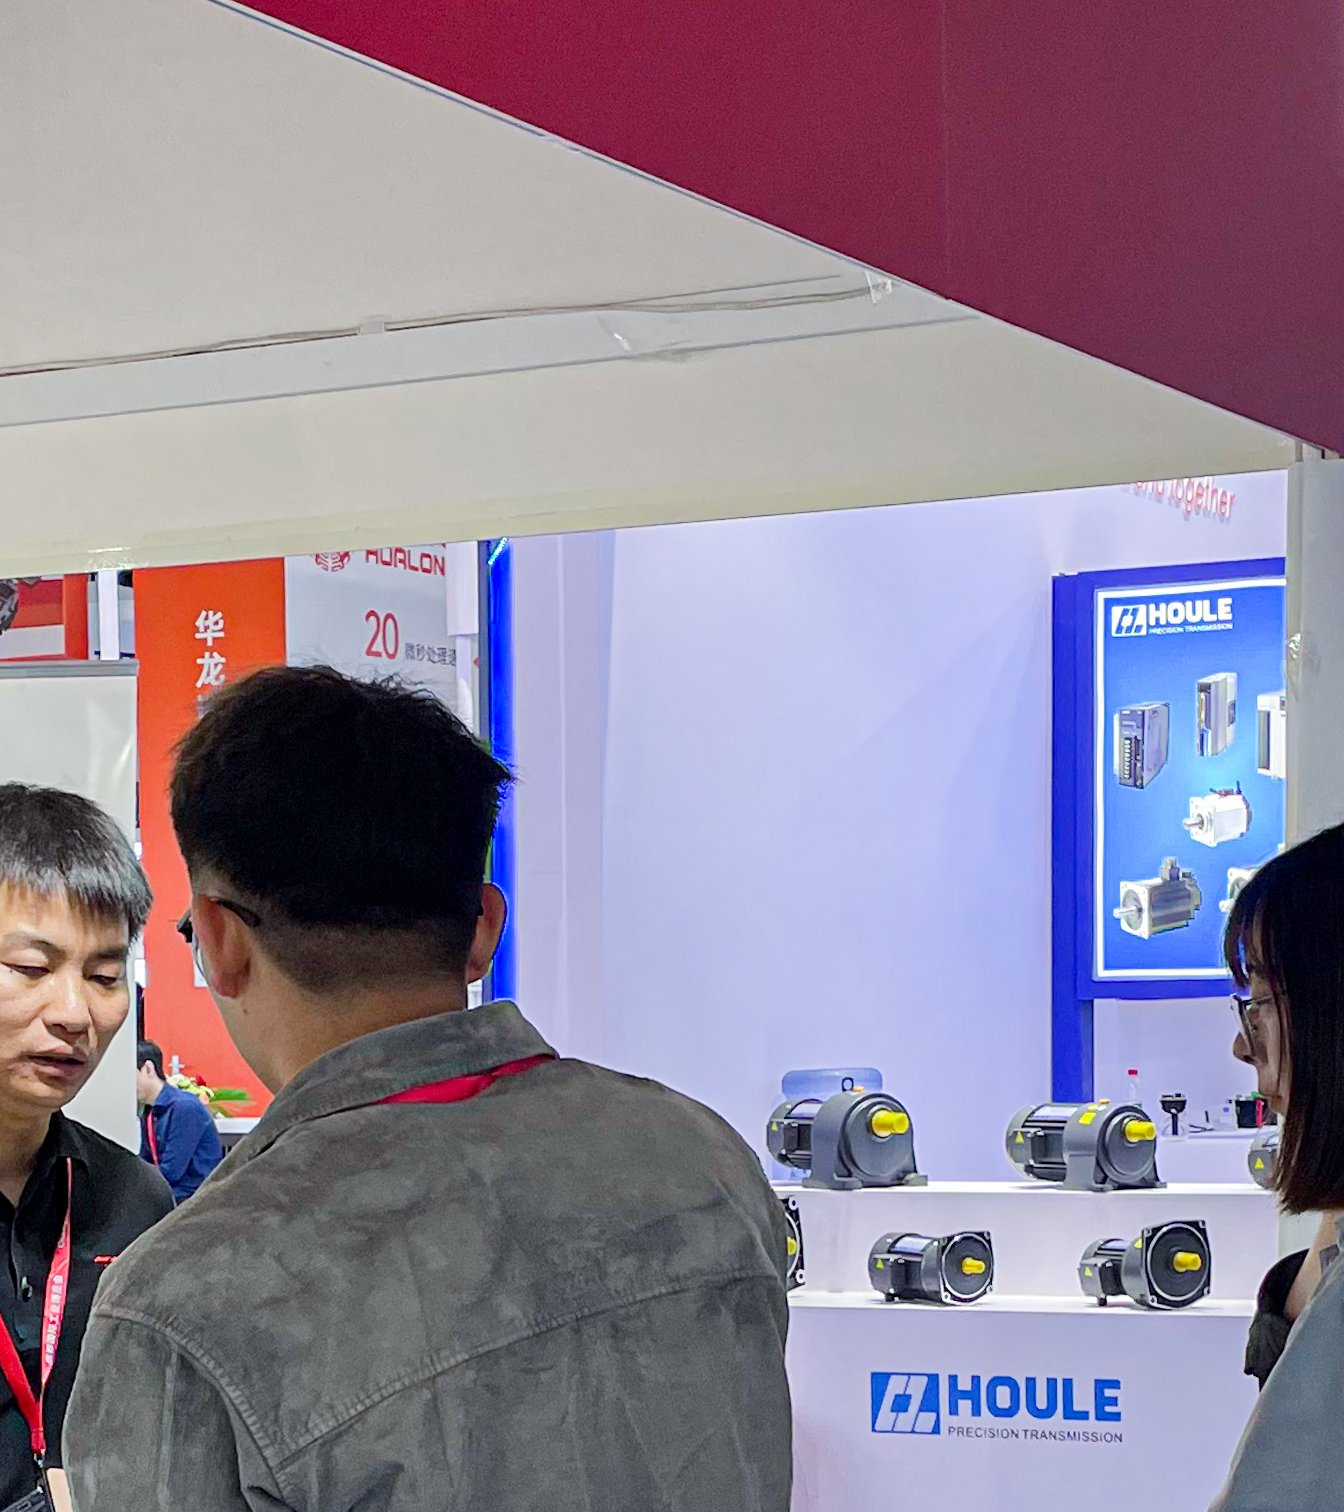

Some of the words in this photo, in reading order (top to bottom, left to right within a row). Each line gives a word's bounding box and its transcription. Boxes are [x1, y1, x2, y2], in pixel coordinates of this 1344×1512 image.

[1148, 597, 1233, 627] HOULE
[365, 610, 399, 660] 20
[948, 1374, 1122, 1422] HOULE
[947, 1426, 1020, 1440] PRECISION
[1022, 1429, 1123, 1443] TRANSMISSION
